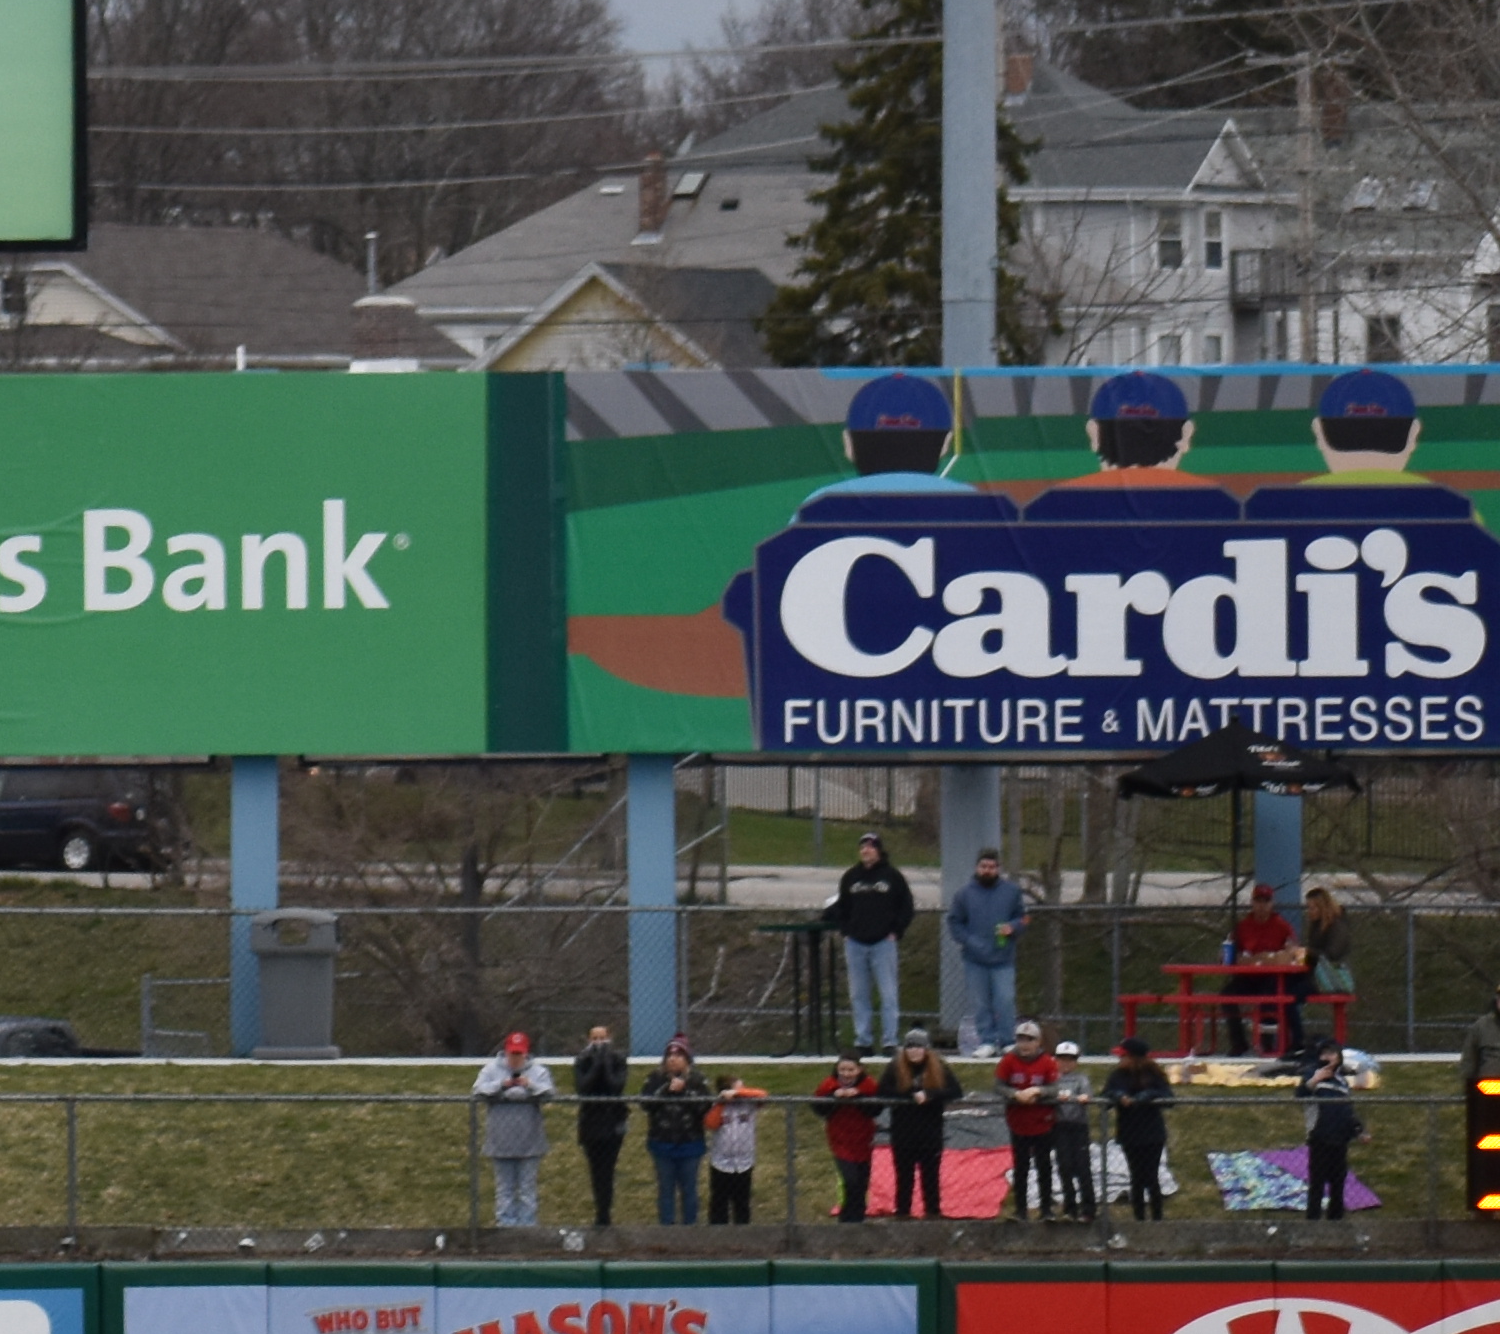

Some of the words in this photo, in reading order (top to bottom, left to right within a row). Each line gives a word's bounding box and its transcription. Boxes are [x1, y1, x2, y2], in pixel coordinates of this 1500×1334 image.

[82, 498, 391, 613] Bank
[780, 528, 1487, 680] Cardi's
[783, 698, 1085, 744] FURNITURE
[1101, 709, 1121, 734] &
[1136, 696, 1485, 742] MATTRESSES
[312, 1311, 368, 1334] WHO
[375, 1305, 422, 1331] BUT
